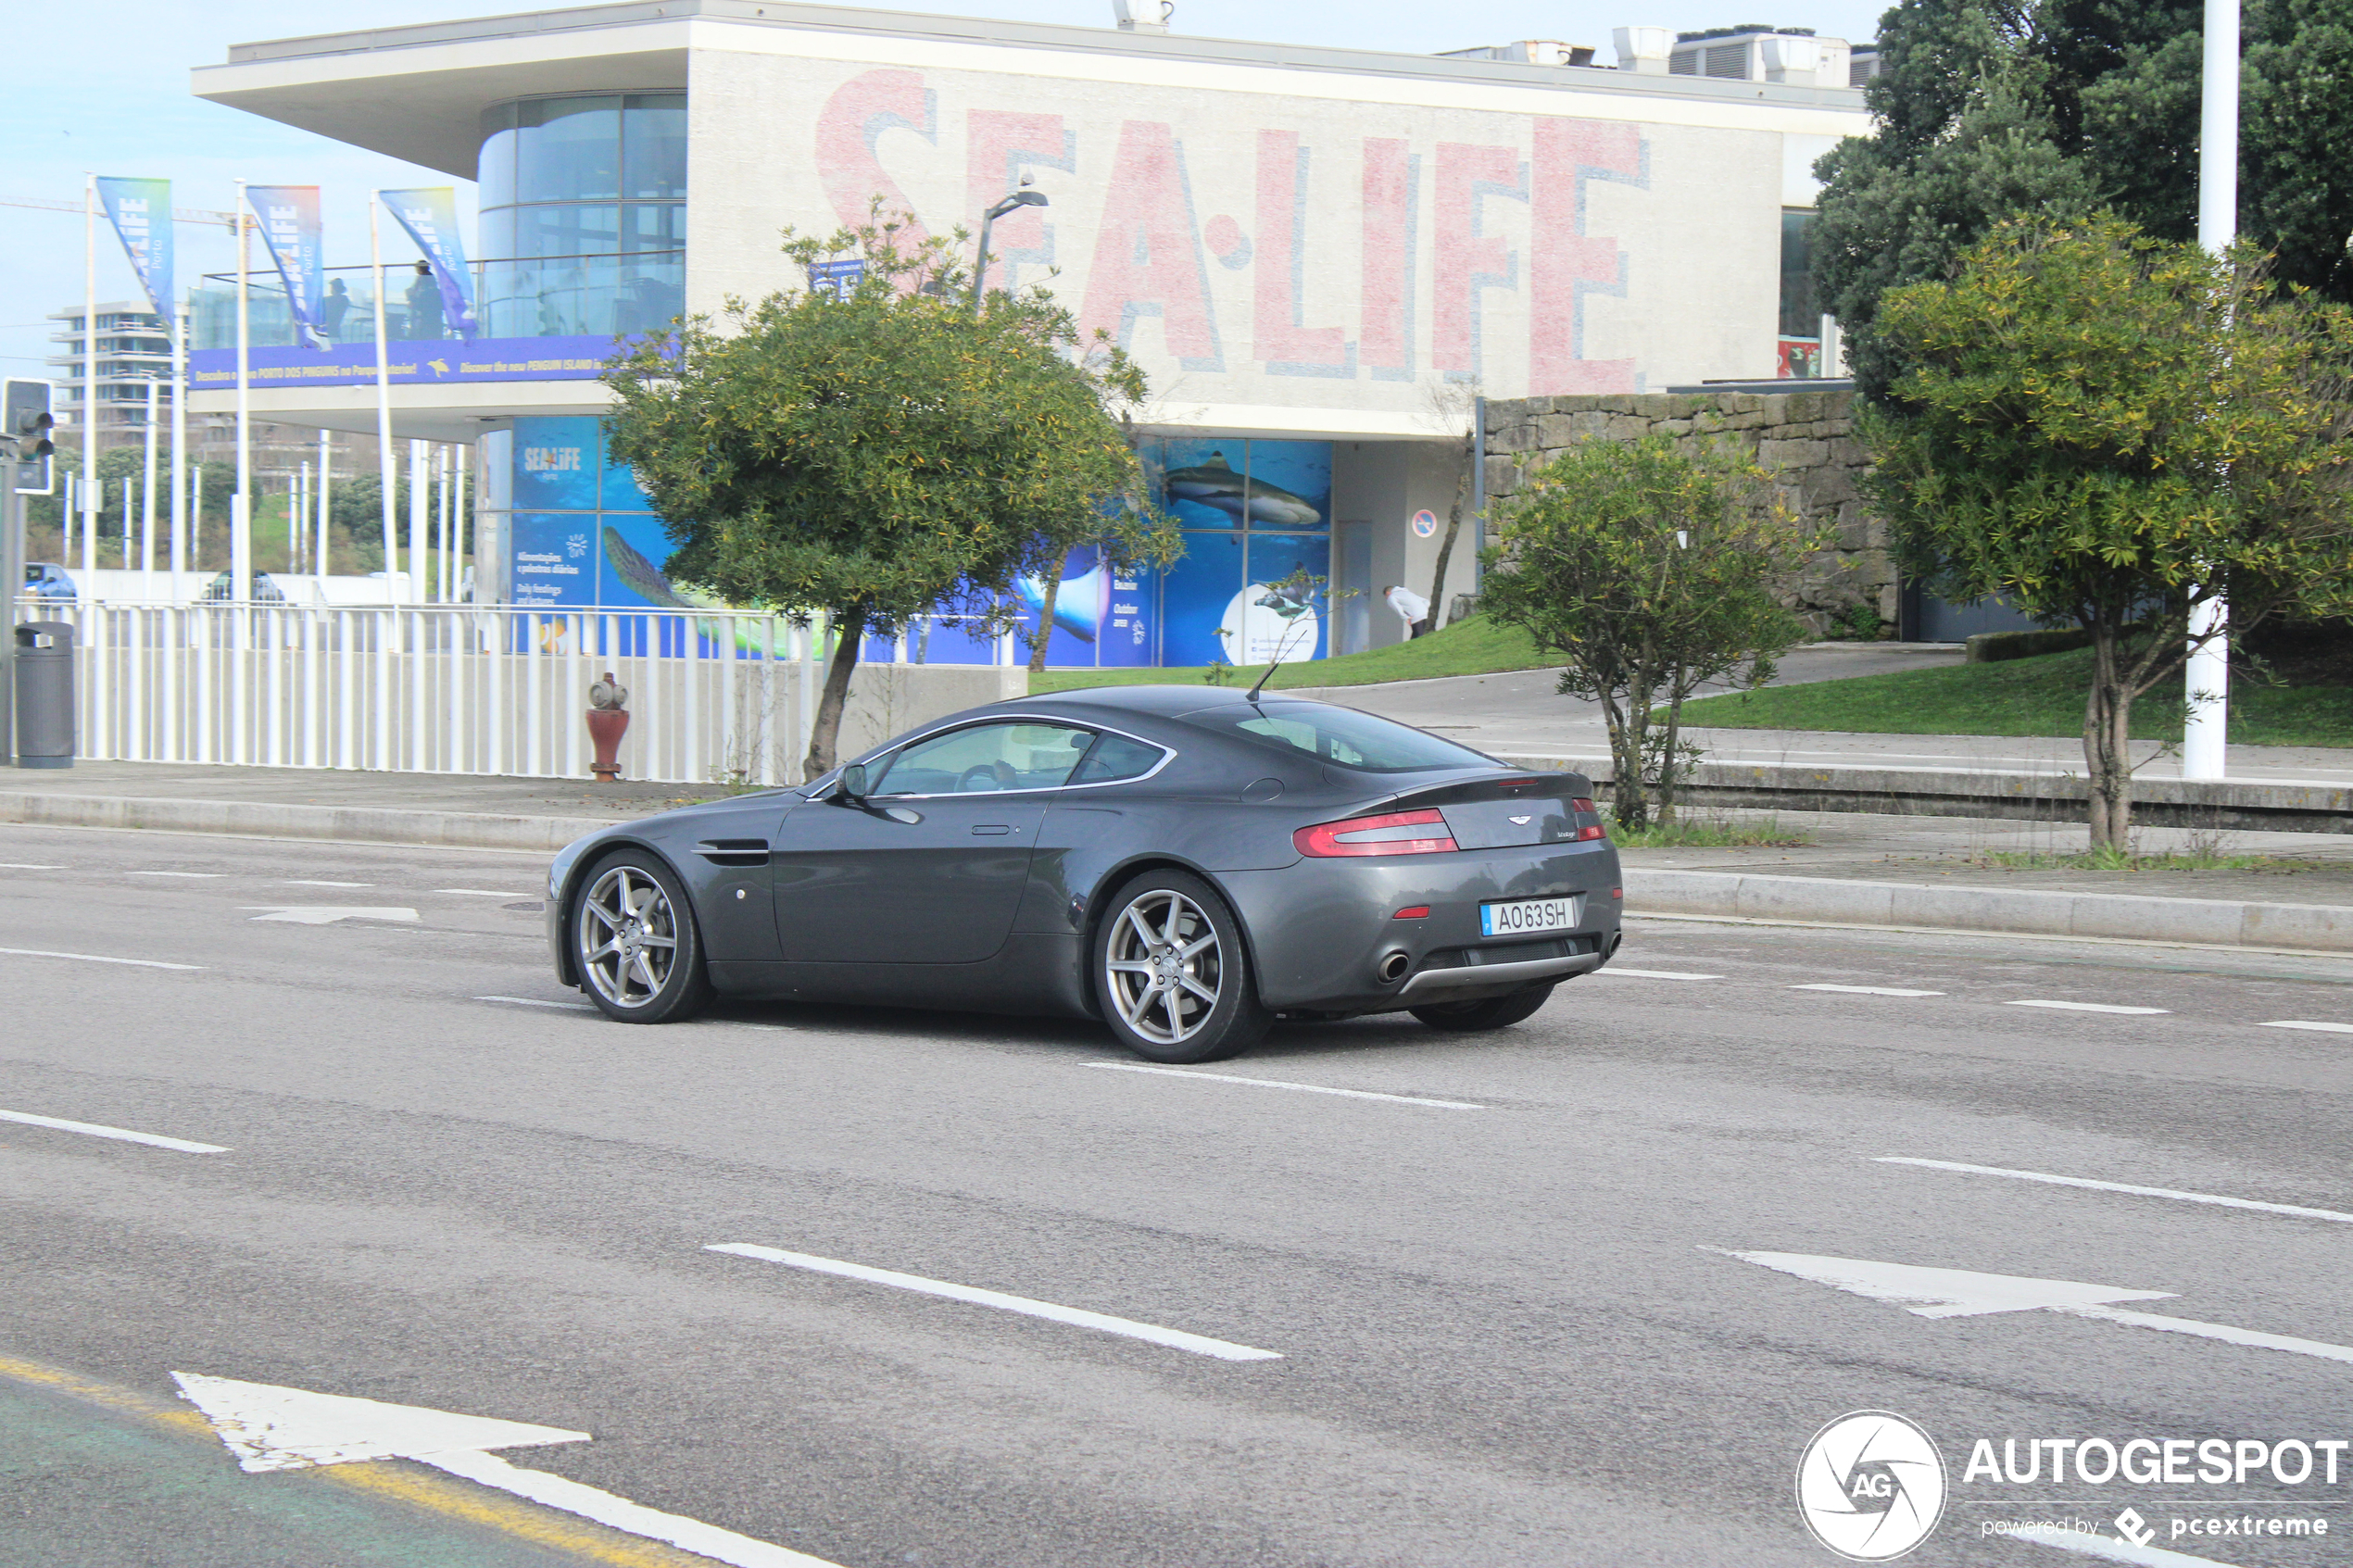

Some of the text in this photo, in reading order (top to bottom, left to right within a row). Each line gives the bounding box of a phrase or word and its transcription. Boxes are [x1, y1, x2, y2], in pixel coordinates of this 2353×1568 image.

[151, 239, 162, 270] Porto
[304, 245, 313, 276] Porto
[444, 245, 458, 271] Porto
[195, 369, 231, 382] Descubra
[258, 367, 283, 379] PORTO
[284, 366, 301, 378] DOS
[302, 365, 340, 378] PINGUINS
[340, 367, 352, 376] no
[459, 361, 493, 373] Discover
[494, 360, 508, 372] the
[508, 362, 526, 371] new
[527, 359, 562, 370] PENGUIN
[563, 358, 592, 370] ISLAND
[533, 583, 562, 596] feedings
[1113, 603, 1139, 614] Outdoor
[1113, 619, 1128, 628] area
